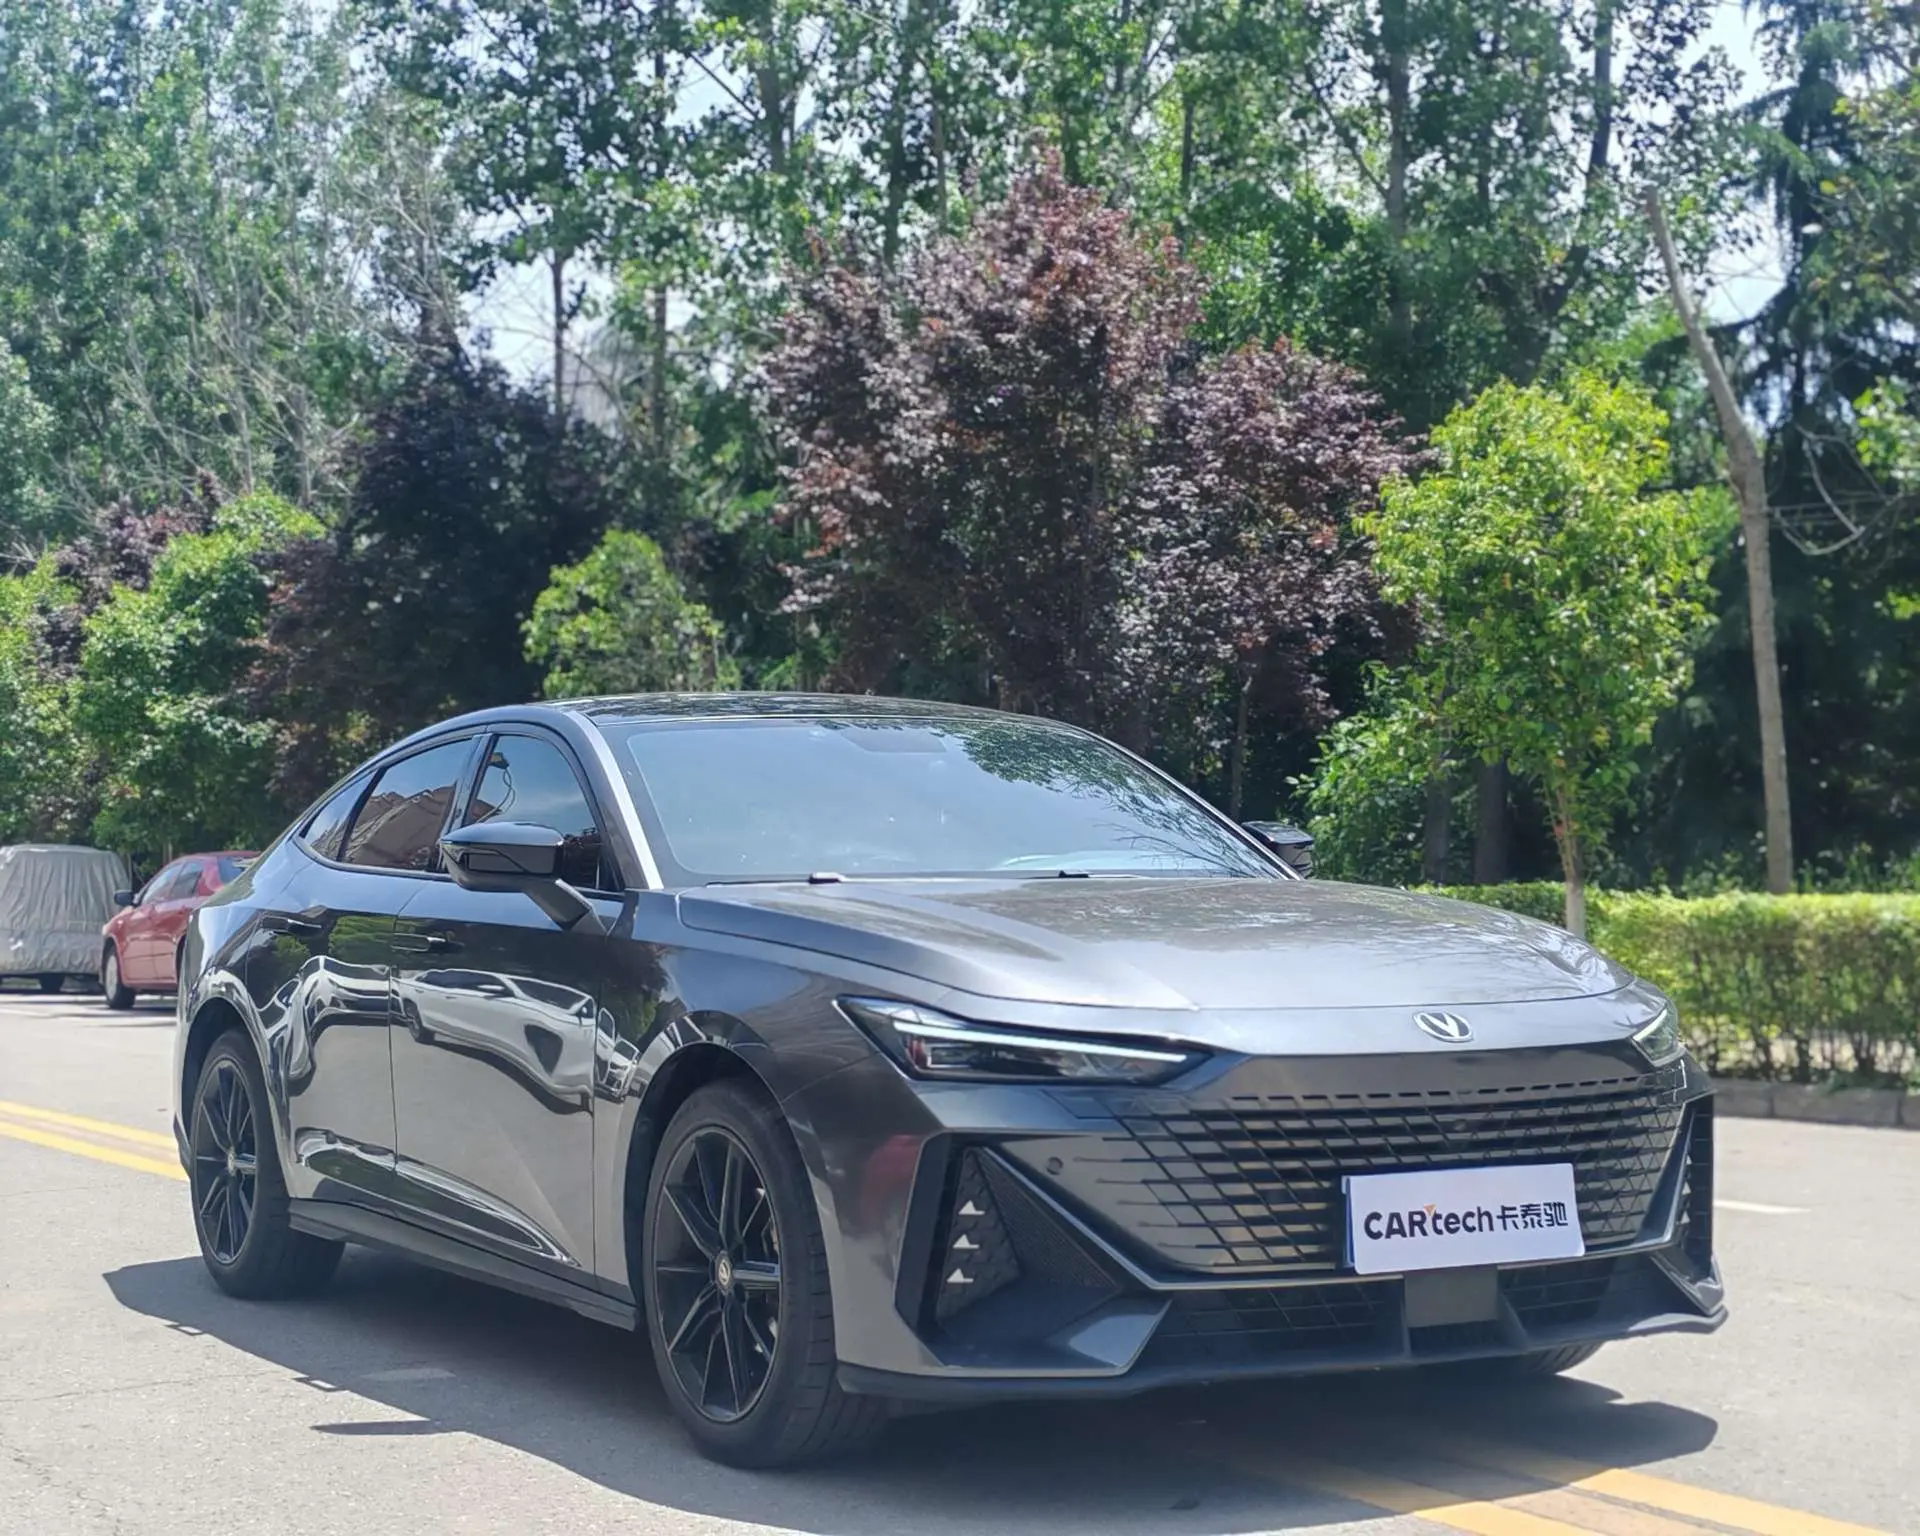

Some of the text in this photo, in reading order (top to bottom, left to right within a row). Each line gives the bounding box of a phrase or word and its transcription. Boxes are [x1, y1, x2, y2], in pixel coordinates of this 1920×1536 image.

[1364, 1201, 1568, 1240] CARtech 卡泰驰
